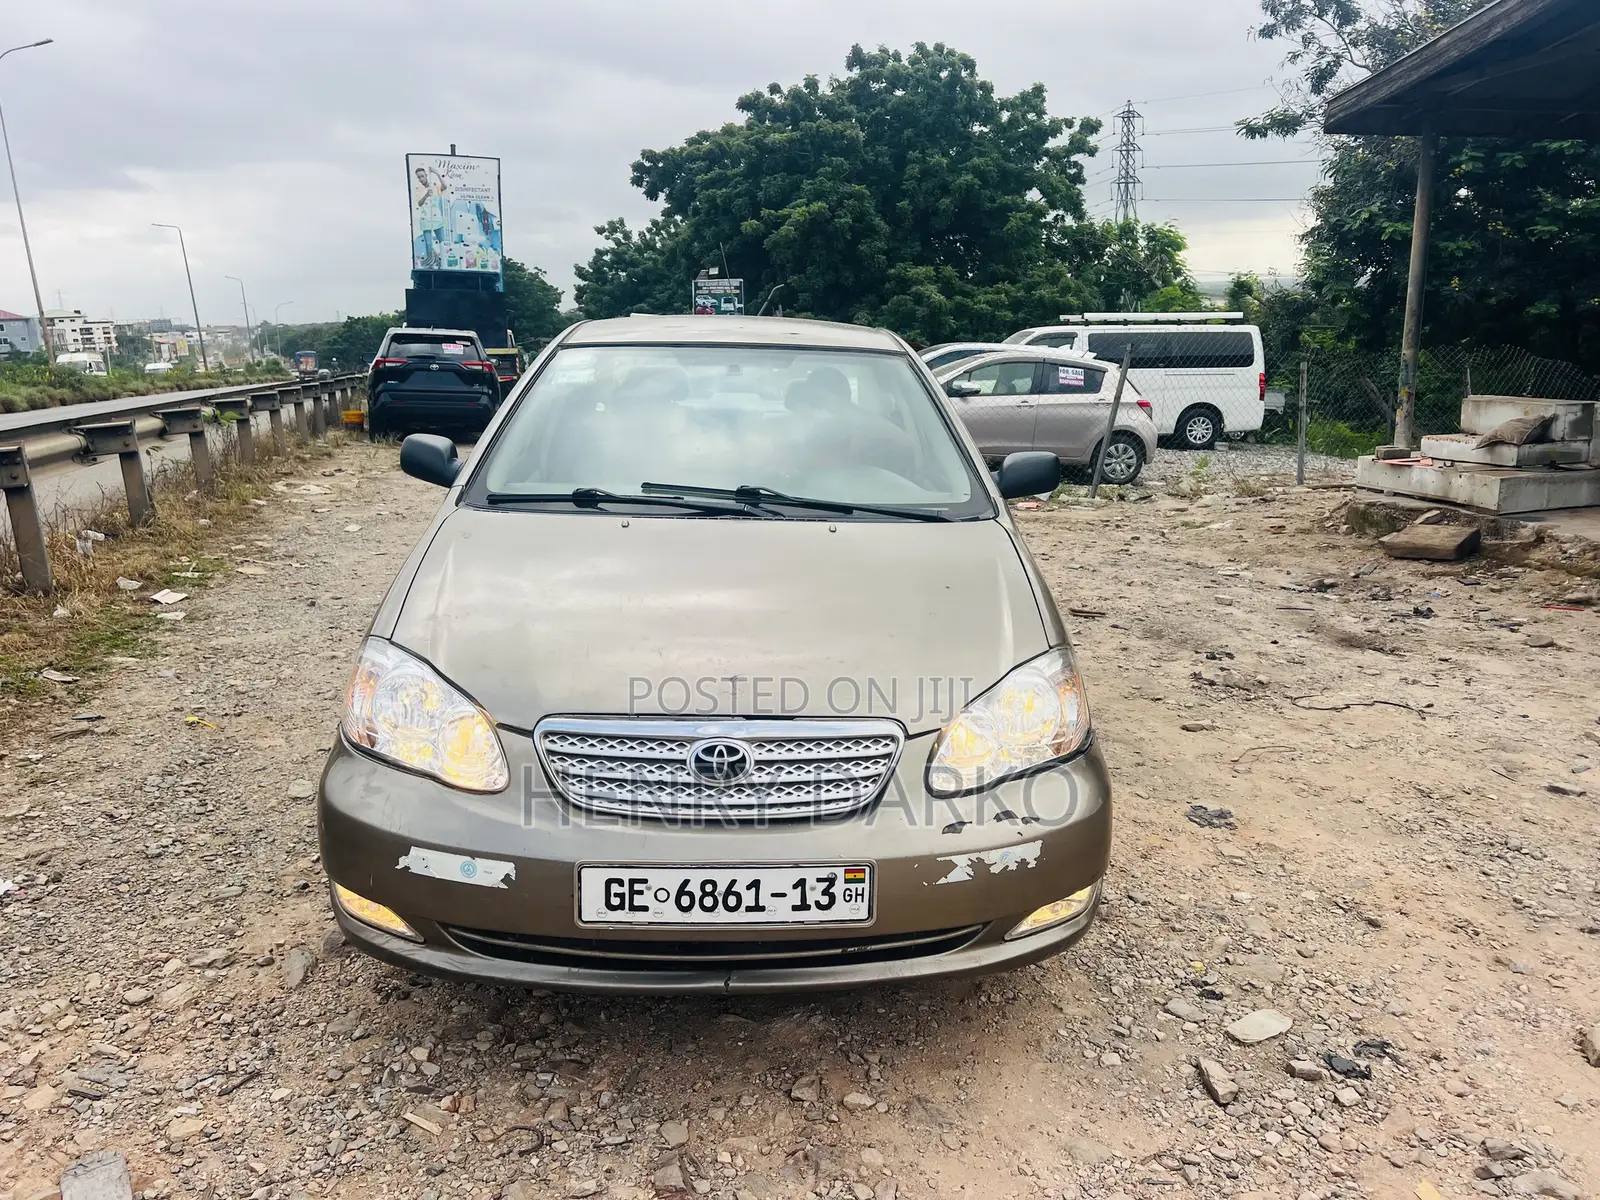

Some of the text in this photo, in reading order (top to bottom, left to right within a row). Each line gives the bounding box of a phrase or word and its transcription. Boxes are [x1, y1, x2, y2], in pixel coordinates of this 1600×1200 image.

[435, 159, 480, 170] Maxim
[604, 877, 837, 913] GE 6861-13
[842, 887, 866, 903] GH
